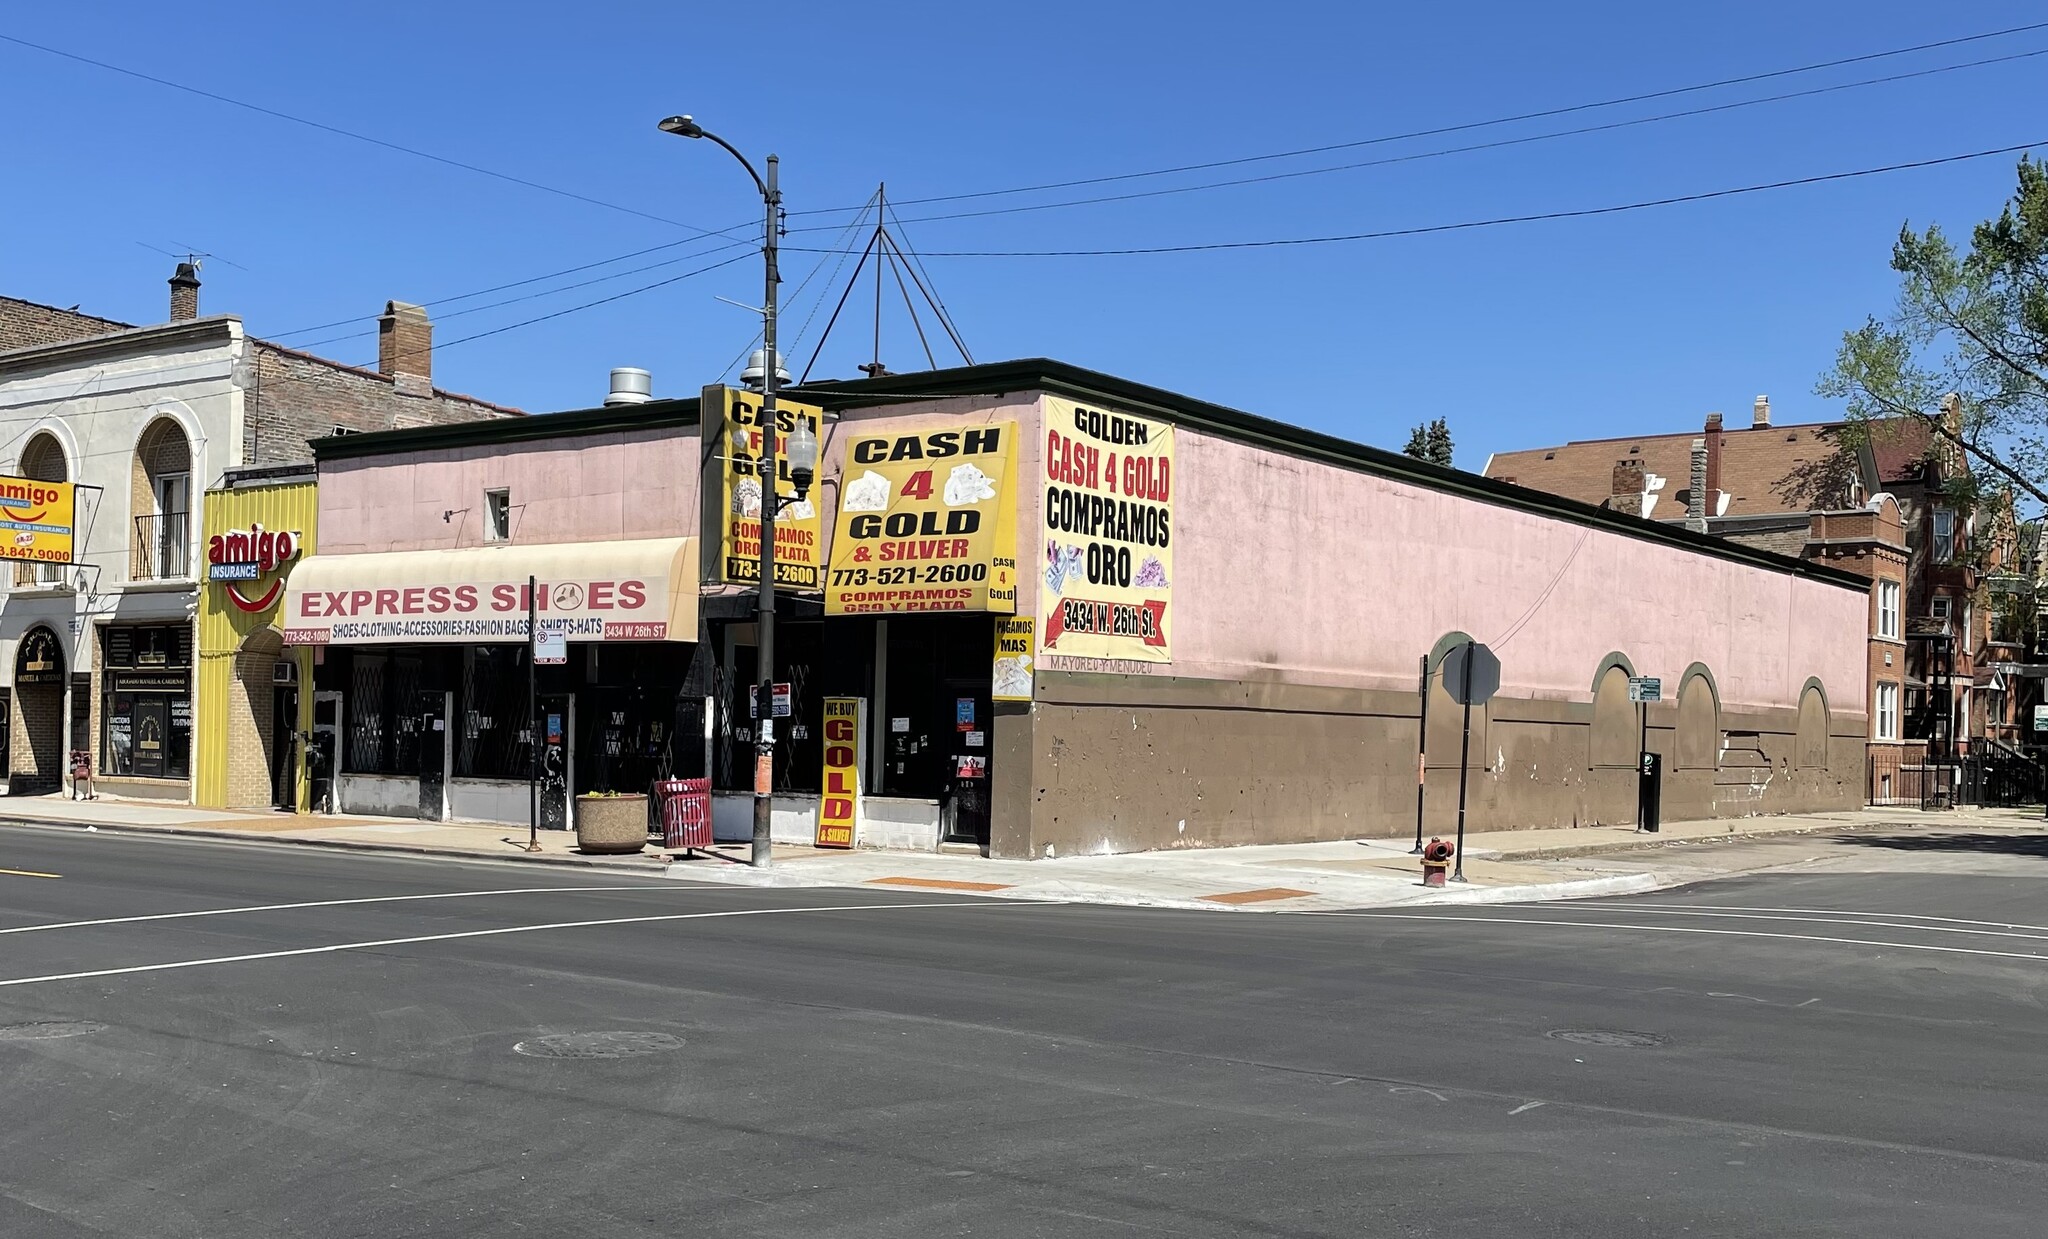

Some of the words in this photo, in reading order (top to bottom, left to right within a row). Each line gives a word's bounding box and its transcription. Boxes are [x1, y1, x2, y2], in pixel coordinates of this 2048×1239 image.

[1075, 407, 1148, 445] GOLDEN
[854, 428, 1001, 464] CASH
[732, 452, 813, 483] GL
[1047, 430, 1100, 490] CASH
[1105, 452, 1117, 493] 4
[1123, 455, 1170, 502] GOLD
[900, 470, 934, 500] 4
[14, 523, 31, 531] AUTO
[32, 525, 69, 534] INSURANCE
[849, 510, 981, 540] GOLD
[1047, 486, 1170, 548] COMPRAMOS
[731, 521, 814, 546] COMAMOS
[208, 522, 295, 571] amigo
[734, 541, 760, 557] ORO
[775, 544, 810, 562] PLATA
[853, 546, 872, 563] &
[879, 539, 969, 562] SILVER
[210, 564, 257, 579] INSURANCE
[731, 560, 814, 584] 773-1-2600
[833, 563, 987, 587] 773-521-2600
[993, 557, 1015, 569] CASH
[1087, 543, 1131, 588] ORO
[999, 571, 1006, 584] 4
[301, 585, 479, 617] EXPRESS
[840, 588, 972, 603] COMPRAMOS
[888, 603, 901, 611] Y
[906, 600, 966, 612] PLATA
[989, 588, 1014, 600] GOLD
[332, 618, 504, 639] SHOES-CLOTHING-ACCESSORIES-FASHION
[605, 626, 624, 638] 3434
[624, 625, 634, 637] W
[634, 624, 652, 637] 26th
[652, 624, 665, 637] ST.
[996, 620, 1033, 634] PAGAMOS
[1064, 601, 1094, 631] 3434
[1097, 603, 1110, 632] W.
[1113, 606, 1138, 635] 26th
[1142, 608, 1156, 637] St.
[285, 629, 330, 643] 773-542-1080
[1000, 639, 1027, 652] MAS
[826, 702, 838, 716] WE
[839, 702, 856, 716] BUY
[823, 719, 854, 820] GOLD
[820, 830, 826, 841] &
[827, 828, 850, 842] SILVER
